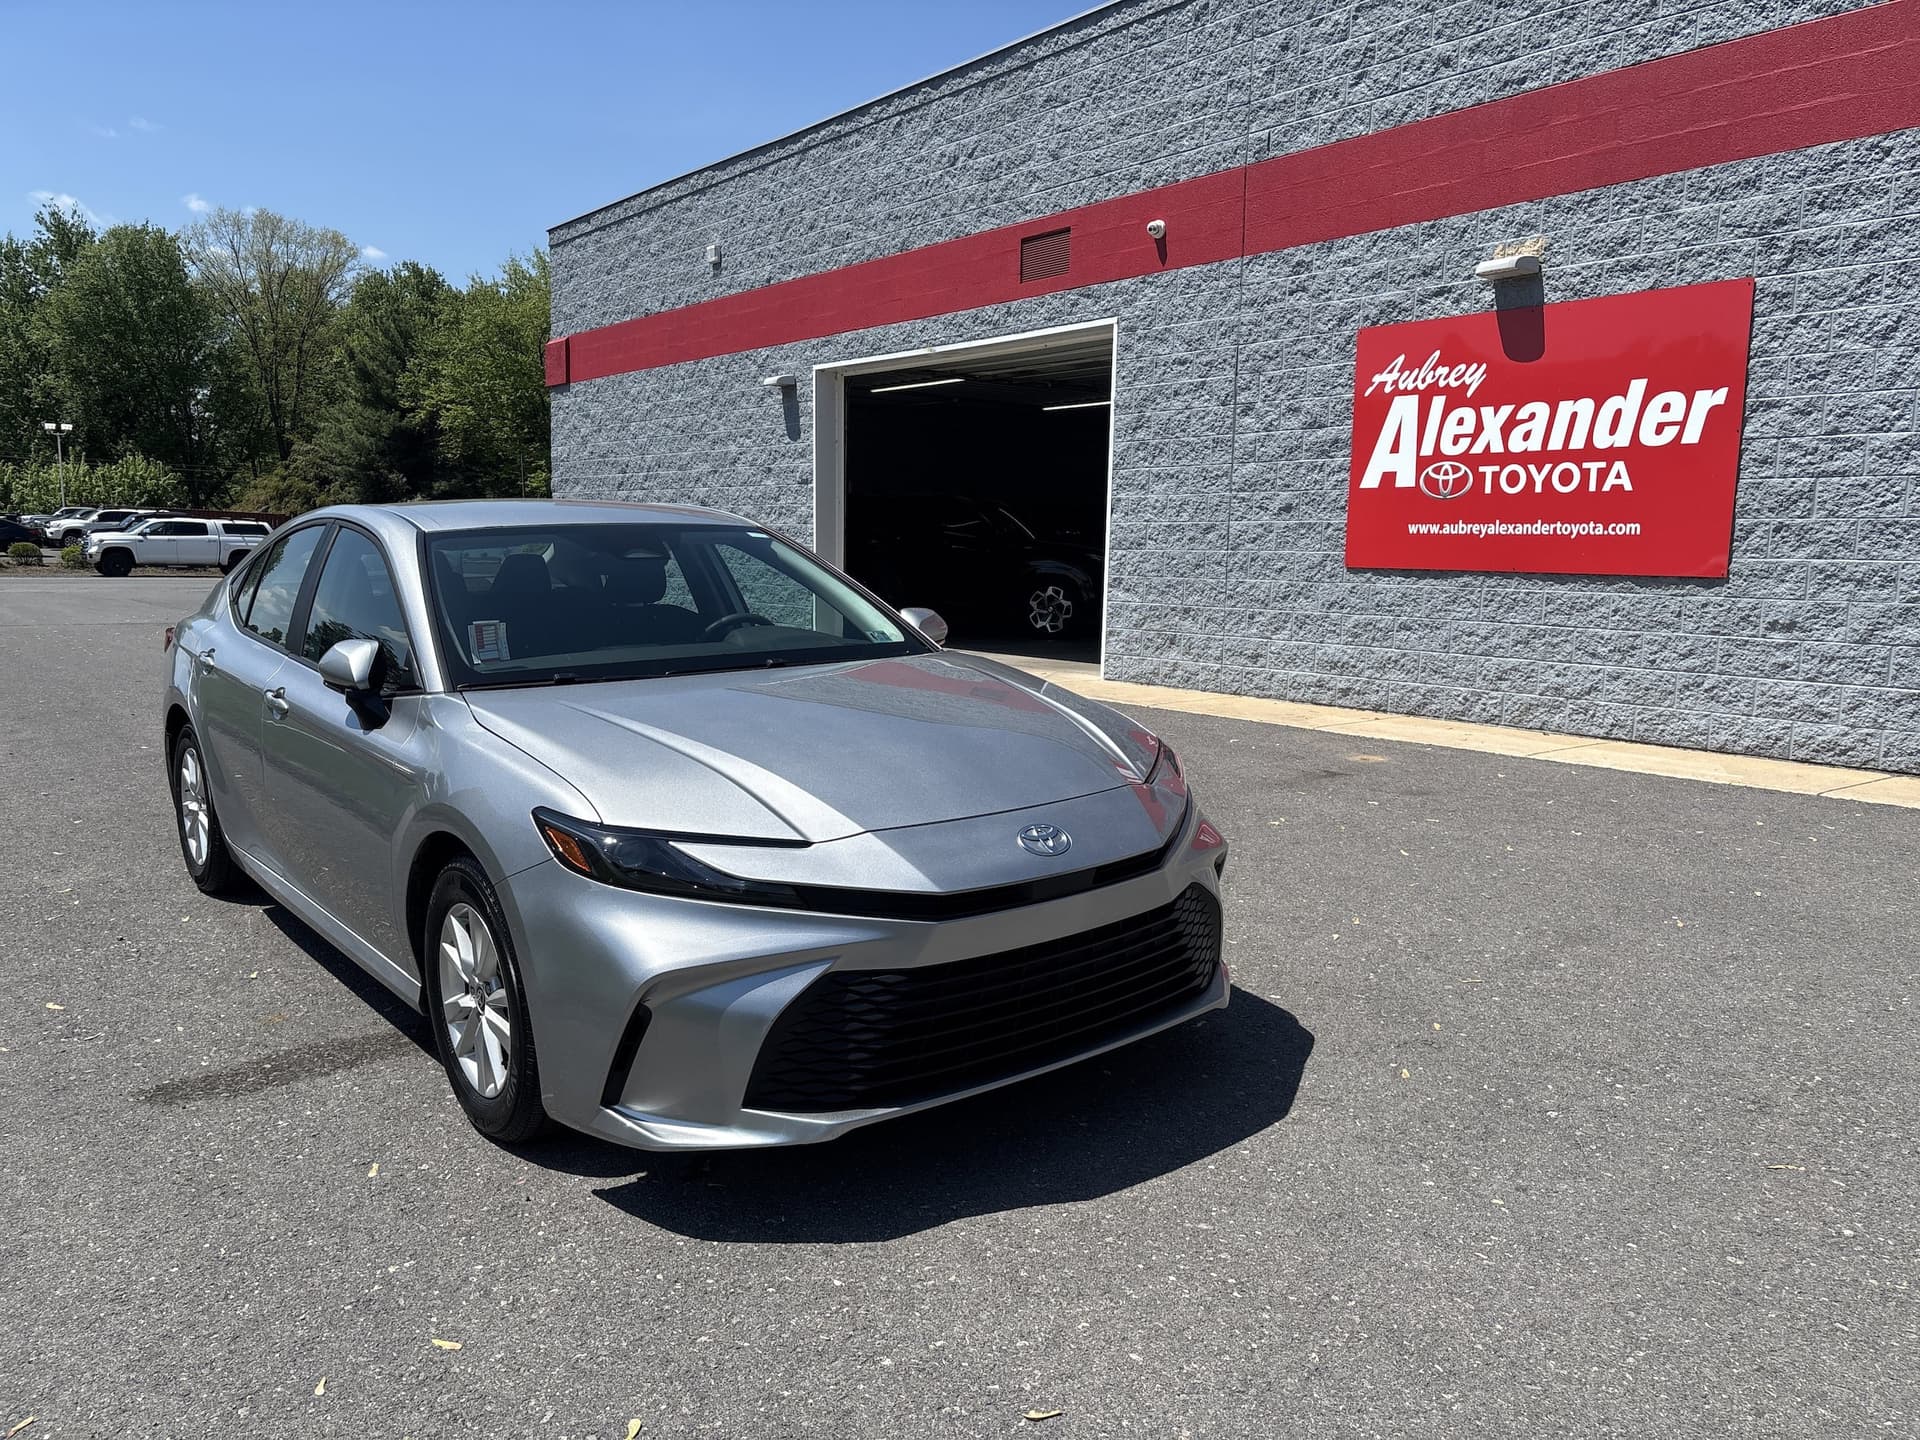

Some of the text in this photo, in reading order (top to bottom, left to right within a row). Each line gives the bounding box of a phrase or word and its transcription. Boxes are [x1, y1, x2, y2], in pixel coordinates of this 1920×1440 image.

[1364, 350, 1487, 398] Aubrey
[1359, 378, 1729, 489] Alexander
[1478, 461, 1633, 494] TOYOTA
[1407, 520, 1641, 539] www.aubreyalexandertoyota.com
